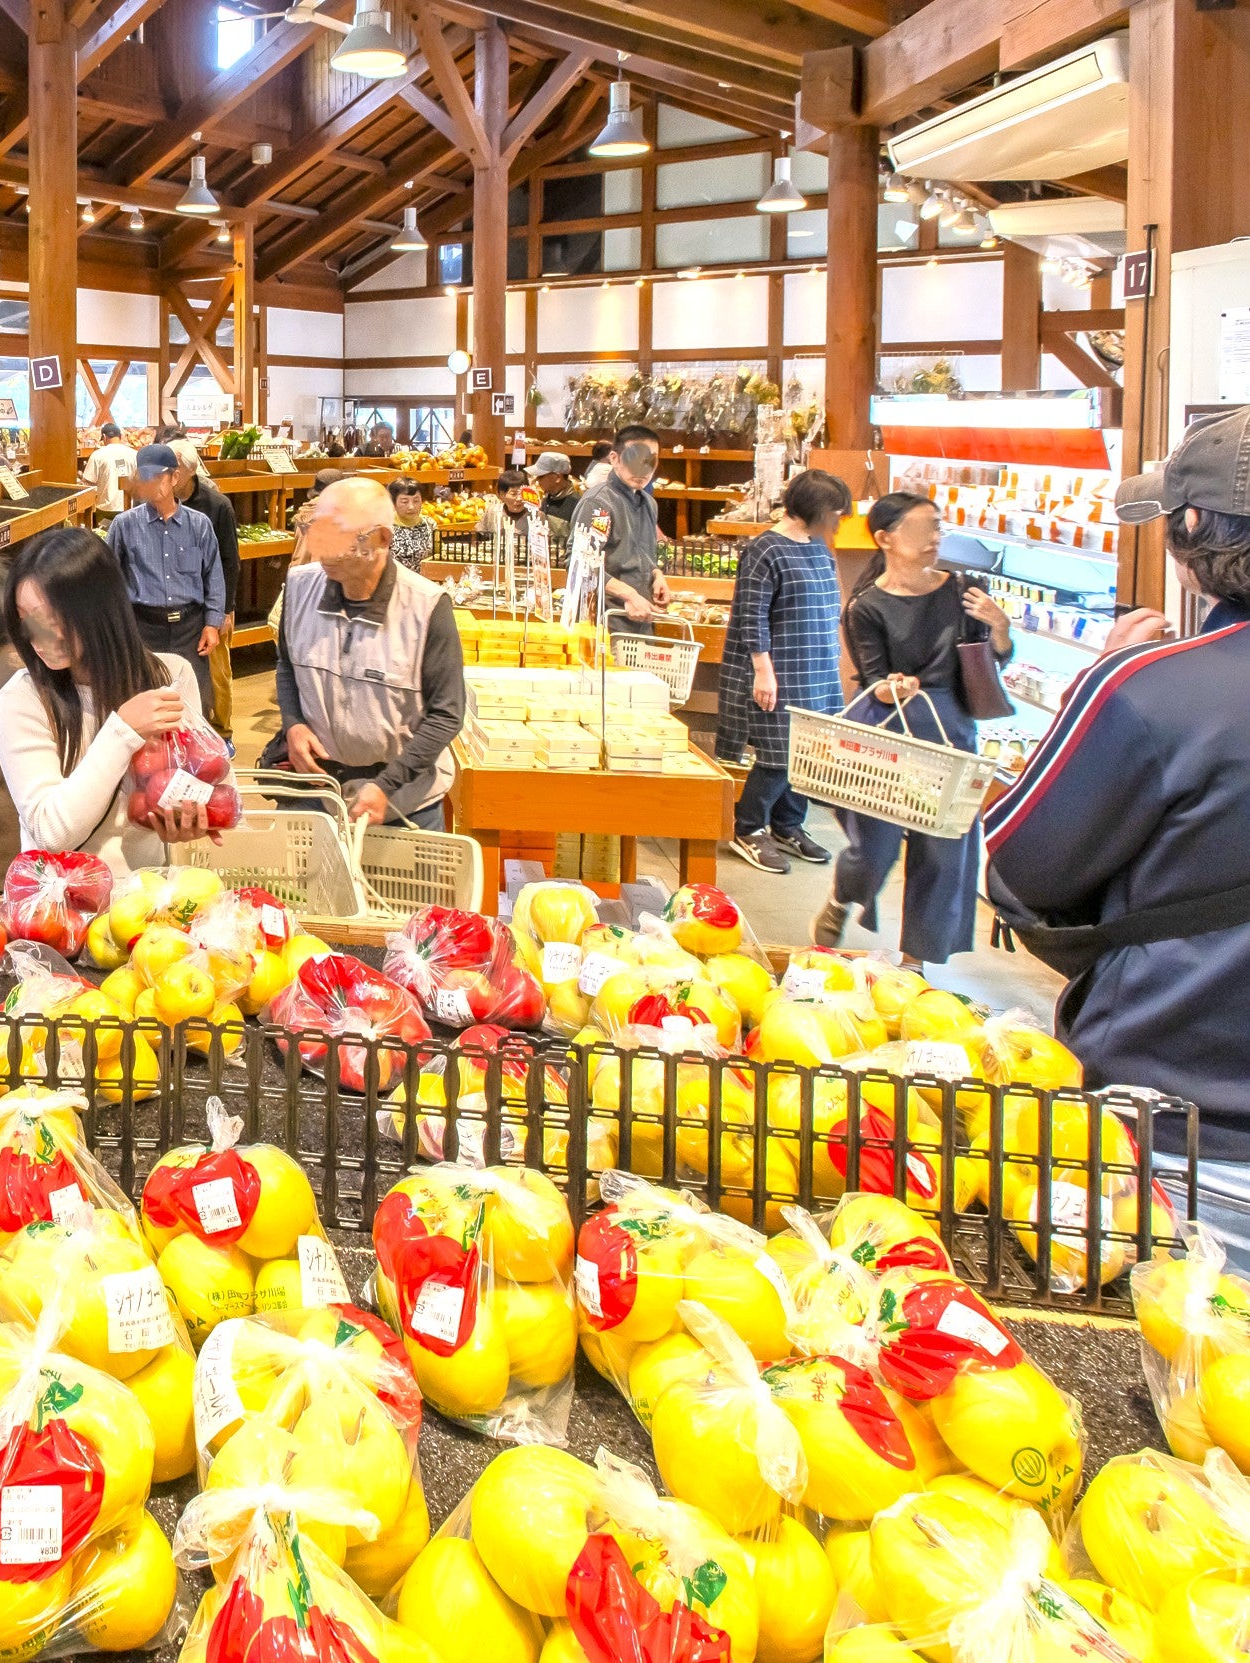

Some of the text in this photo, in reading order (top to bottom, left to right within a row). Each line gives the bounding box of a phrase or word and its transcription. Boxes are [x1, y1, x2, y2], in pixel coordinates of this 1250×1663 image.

[1128, 262, 1147, 288] 17
[39, 365, 54, 382] D
[476, 373, 487, 385] E
[40, 1545, 59, 1555] ¥830
